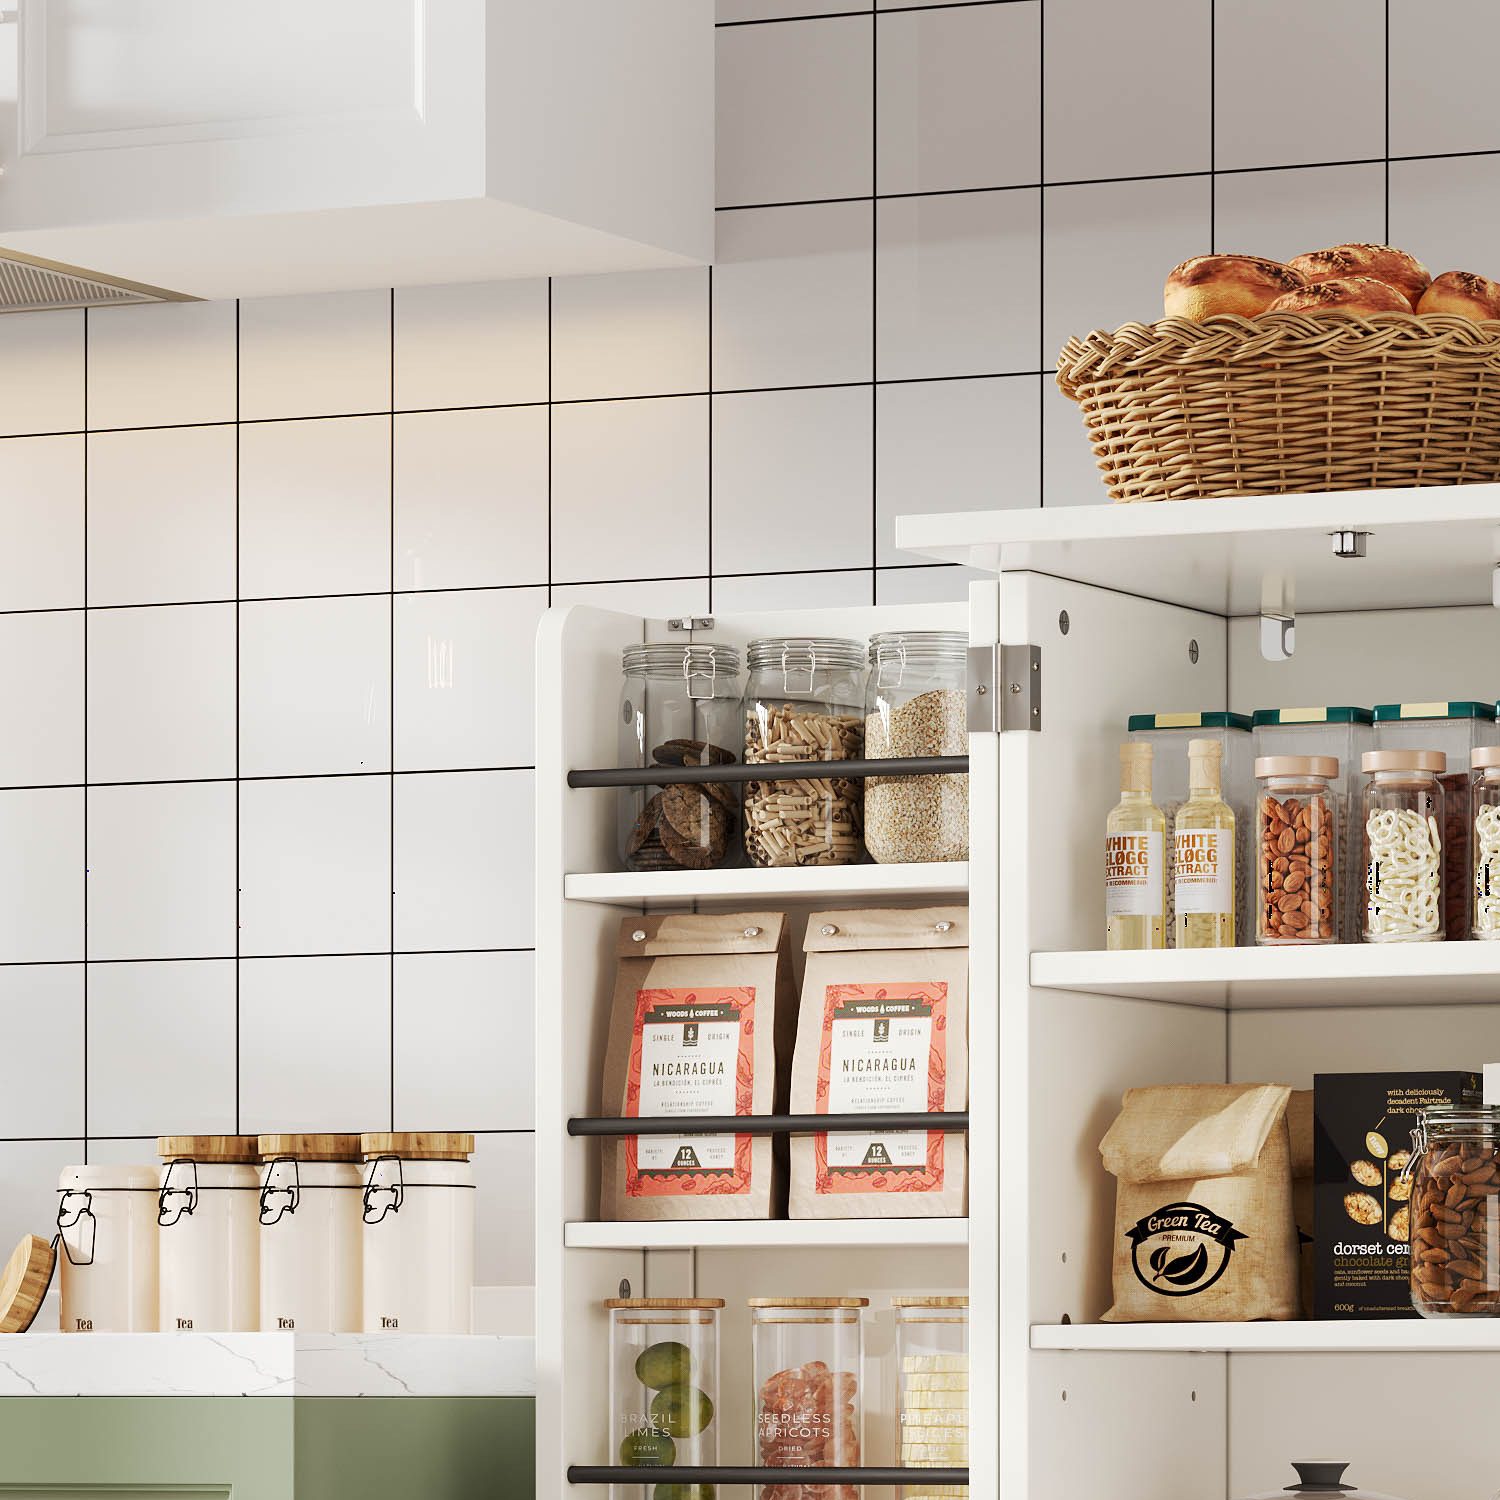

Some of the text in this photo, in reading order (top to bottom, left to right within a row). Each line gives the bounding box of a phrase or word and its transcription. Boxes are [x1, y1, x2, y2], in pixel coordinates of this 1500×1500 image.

[666, 1009, 718, 1018] WOODS COFFEE
[886, 1005, 910, 1013] COFFEE
[653, 1033, 730, 1042] SINGLE ORIGIN
[653, 1062, 725, 1076] NICARAGUA
[842, 1058, 916, 1072] NICARAGUA
[1369, 1136, 1385, 1155] new
[681, 1149, 691, 1160] 12
[871, 1146, 882, 1156] 12
[1147, 1214, 1222, 1234] Green Tea
[1334, 1242, 1383, 1255] dorset
[1335, 1257, 1392, 1267] chocolate
[1334, 1304, 1354, 1312] 600g
[76, 1318, 93, 1329] Tea
[176, 1318, 193, 1329] Tea
[277, 1318, 295, 1328] Tea
[380, 1317, 399, 1328] Tea
[621, 1413, 676, 1423] BRAZIL
[758, 1414, 831, 1423] SEEDLESS
[625, 1428, 671, 1437] LIMES
[759, 1428, 830, 1437] APRICOTS
